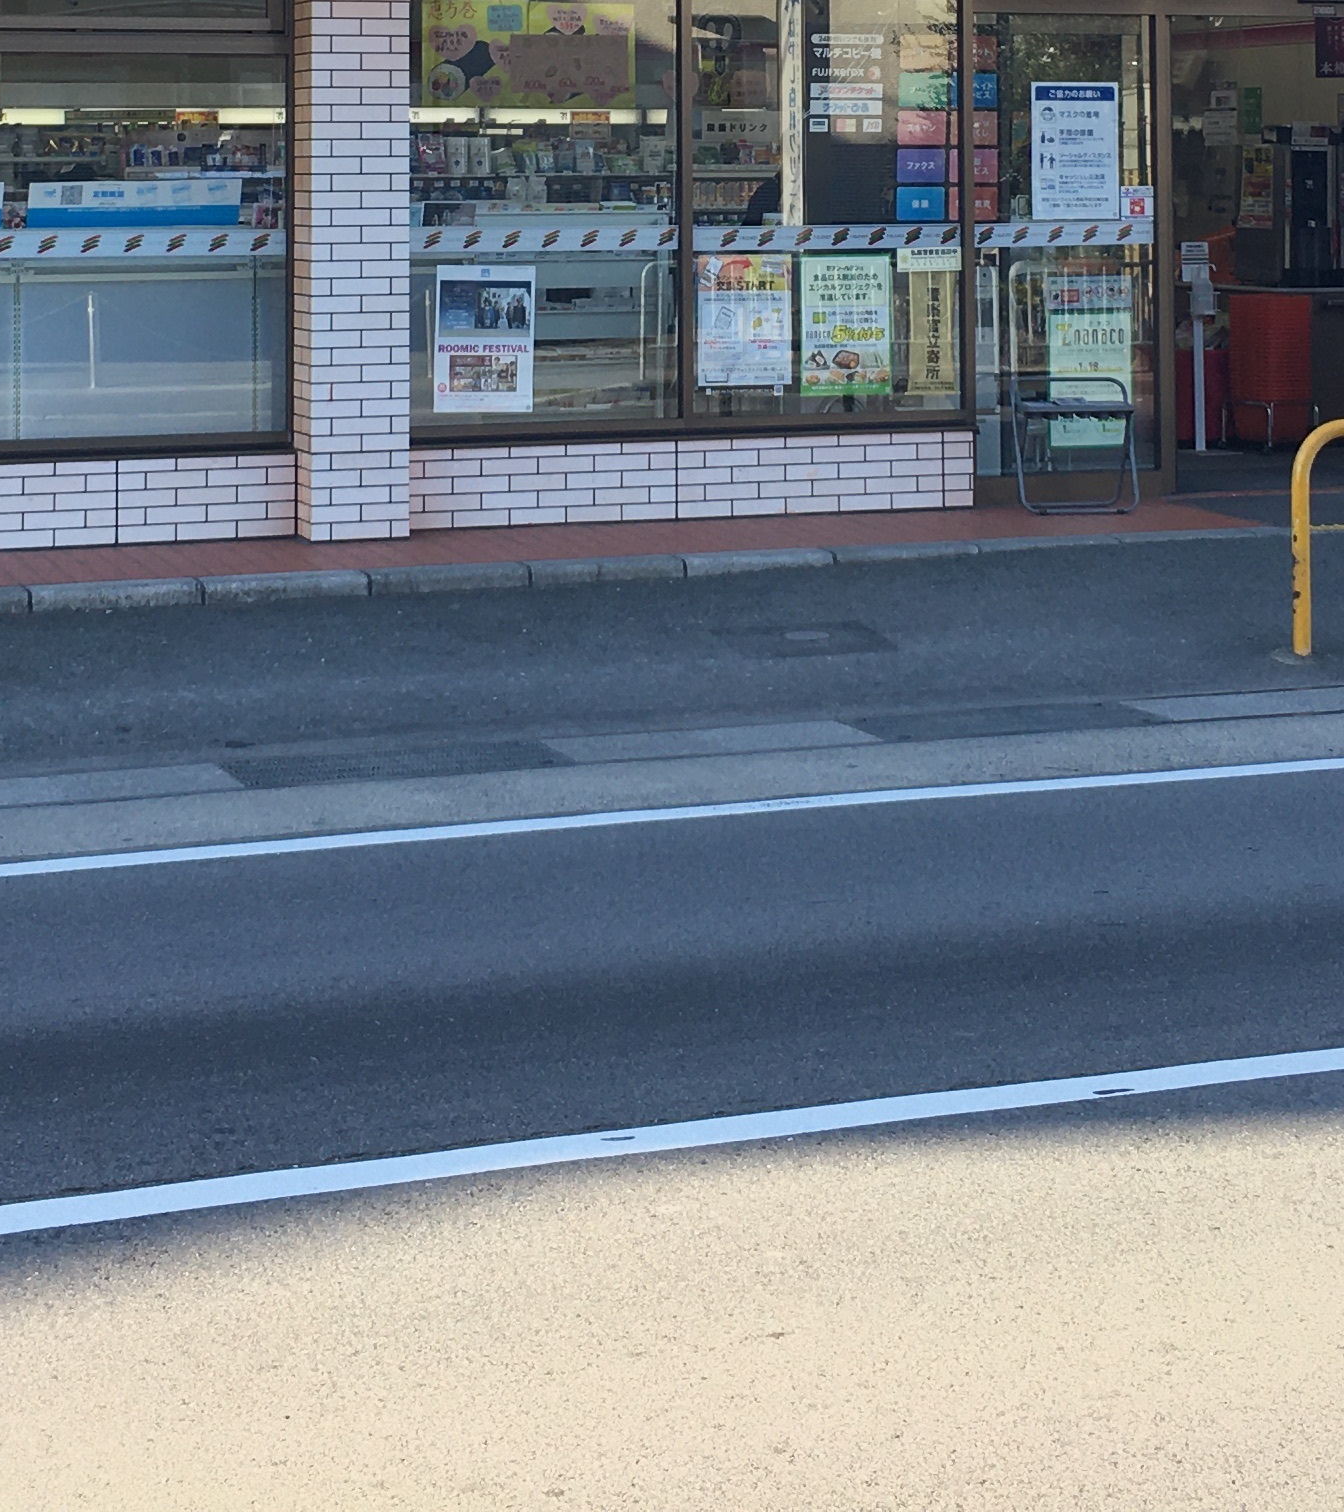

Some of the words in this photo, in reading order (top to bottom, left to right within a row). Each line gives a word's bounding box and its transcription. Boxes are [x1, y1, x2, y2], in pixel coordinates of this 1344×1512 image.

[1073, 328, 1125, 345] nanaco
[438, 344, 479, 353] ROOMIC
[483, 343, 529, 353] FESTIVAL
